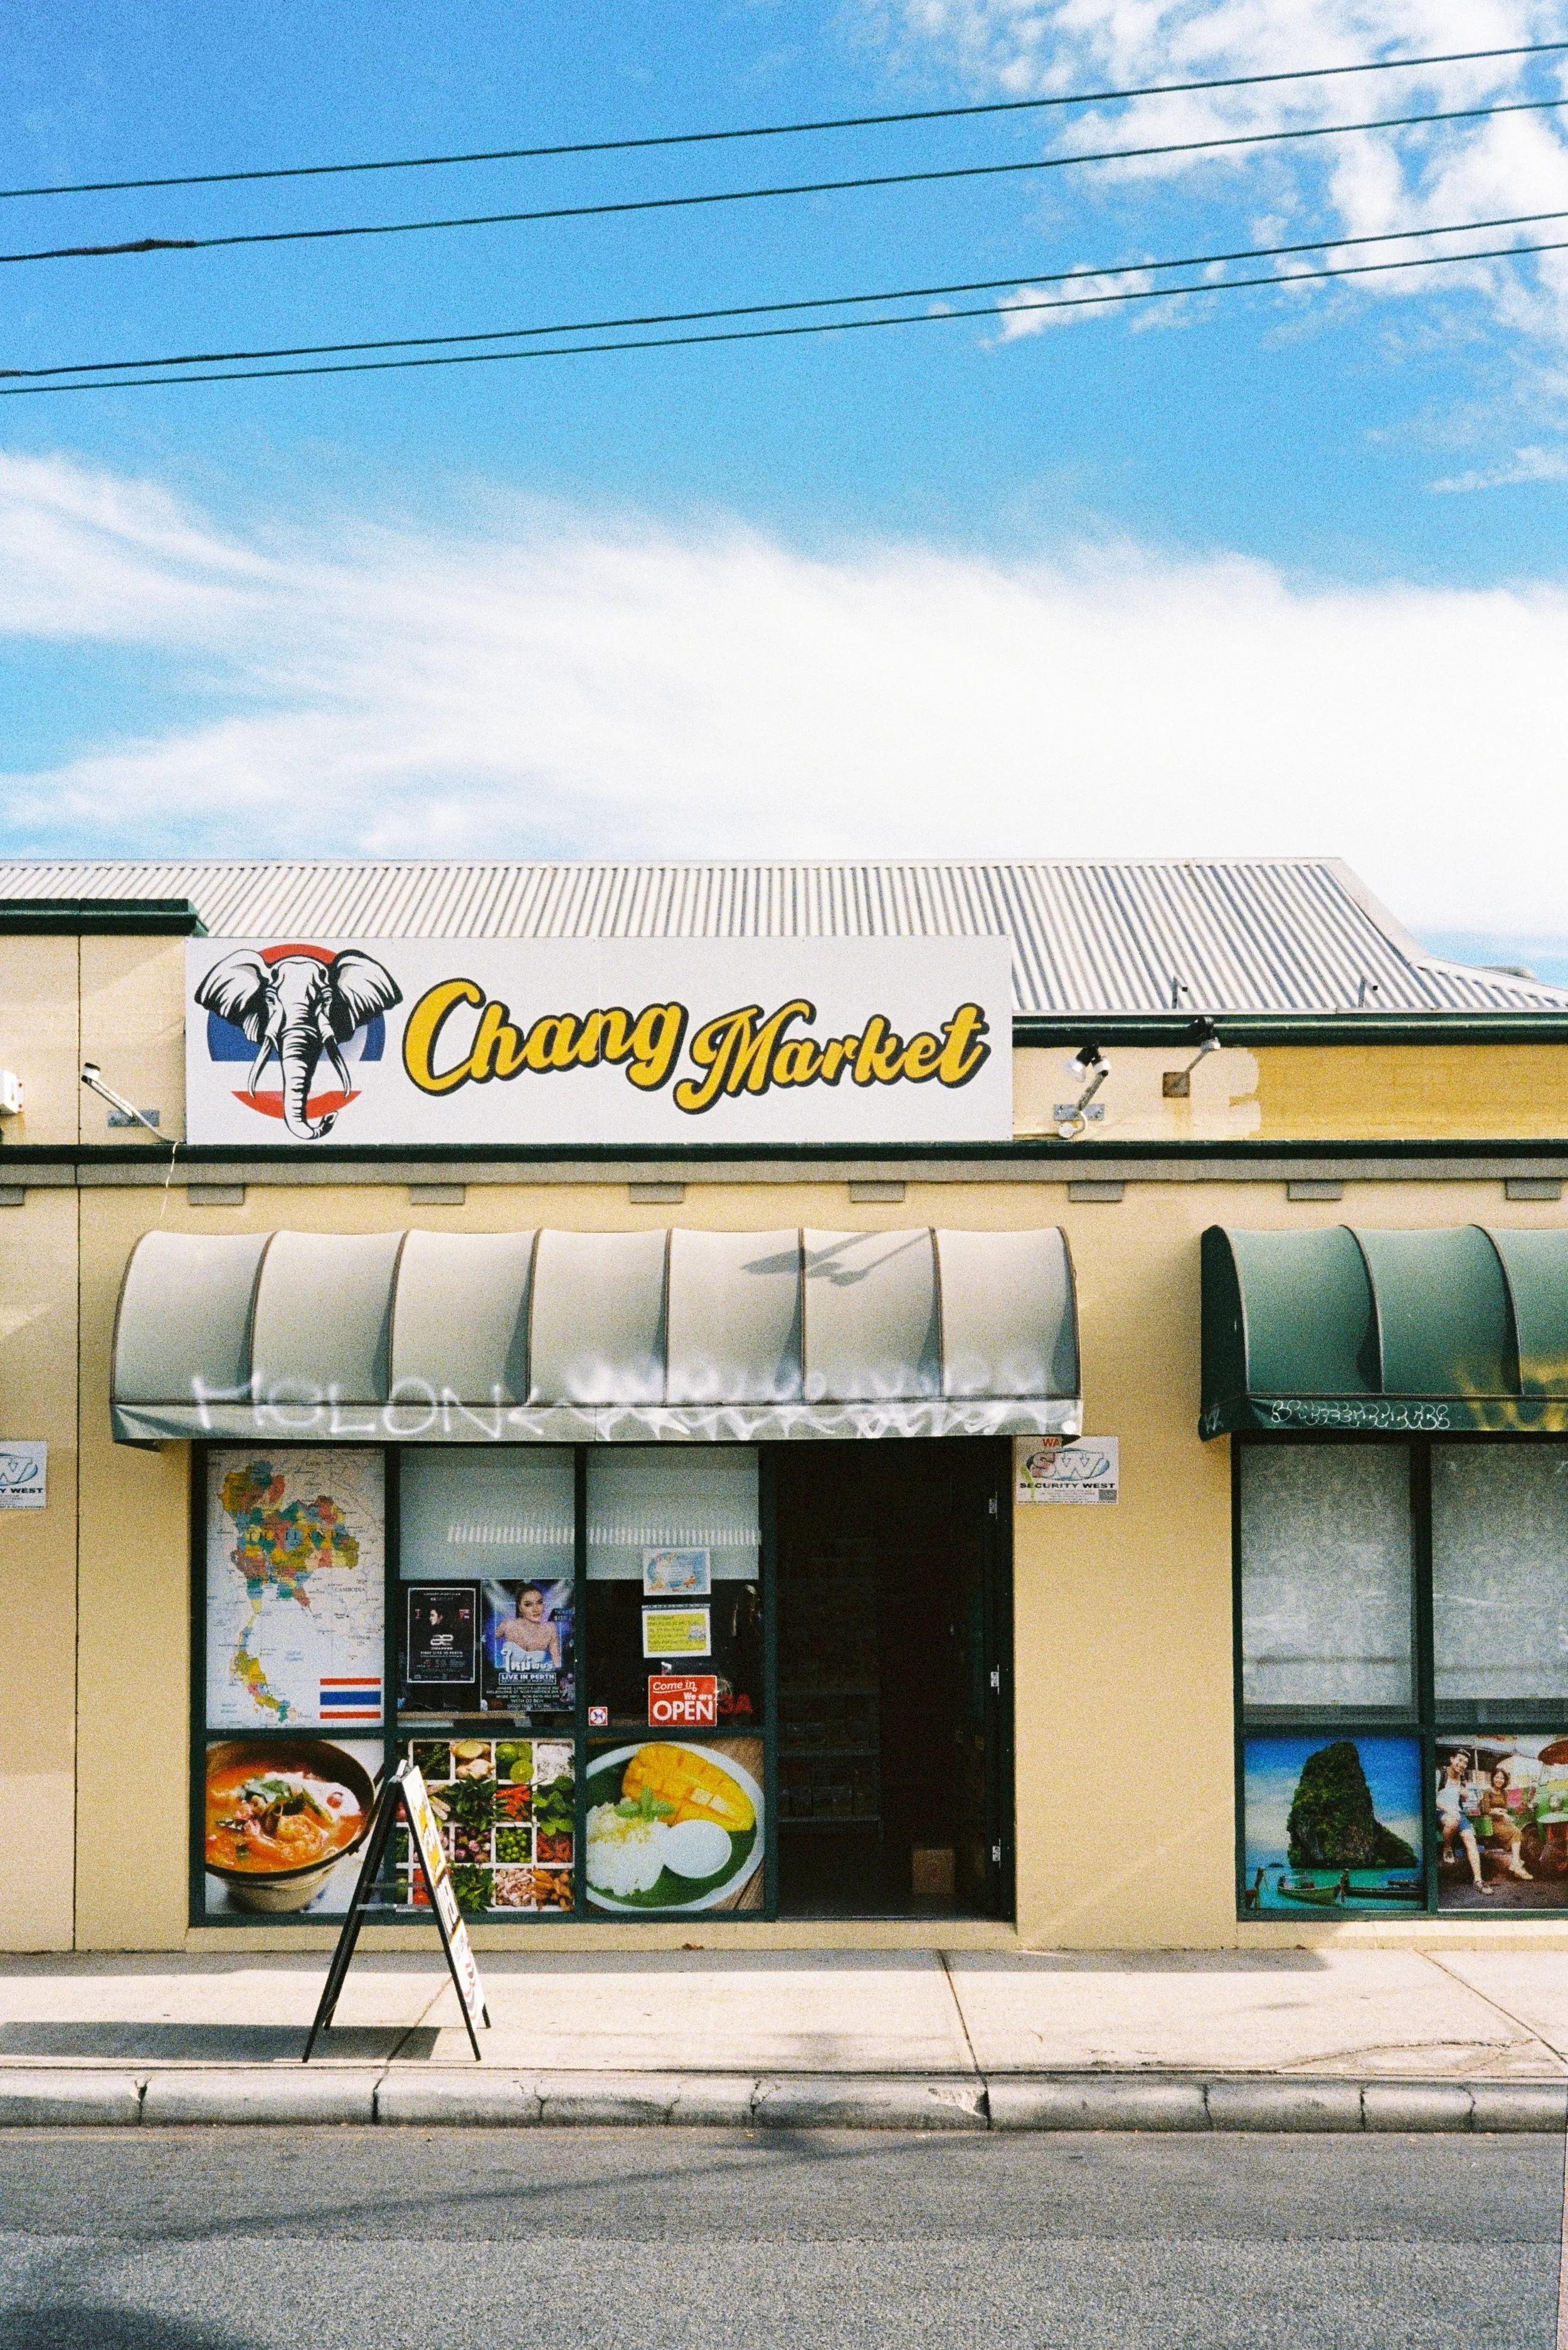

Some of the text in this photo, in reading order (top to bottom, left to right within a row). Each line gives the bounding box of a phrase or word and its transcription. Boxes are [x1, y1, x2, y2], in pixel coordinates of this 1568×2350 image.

[401, 977, 990, 1115] Chang Market
[652, 1679, 696, 1691] Come in
[684, 1692, 696, 1701] We
[653, 1700, 713, 1721] OPEN
